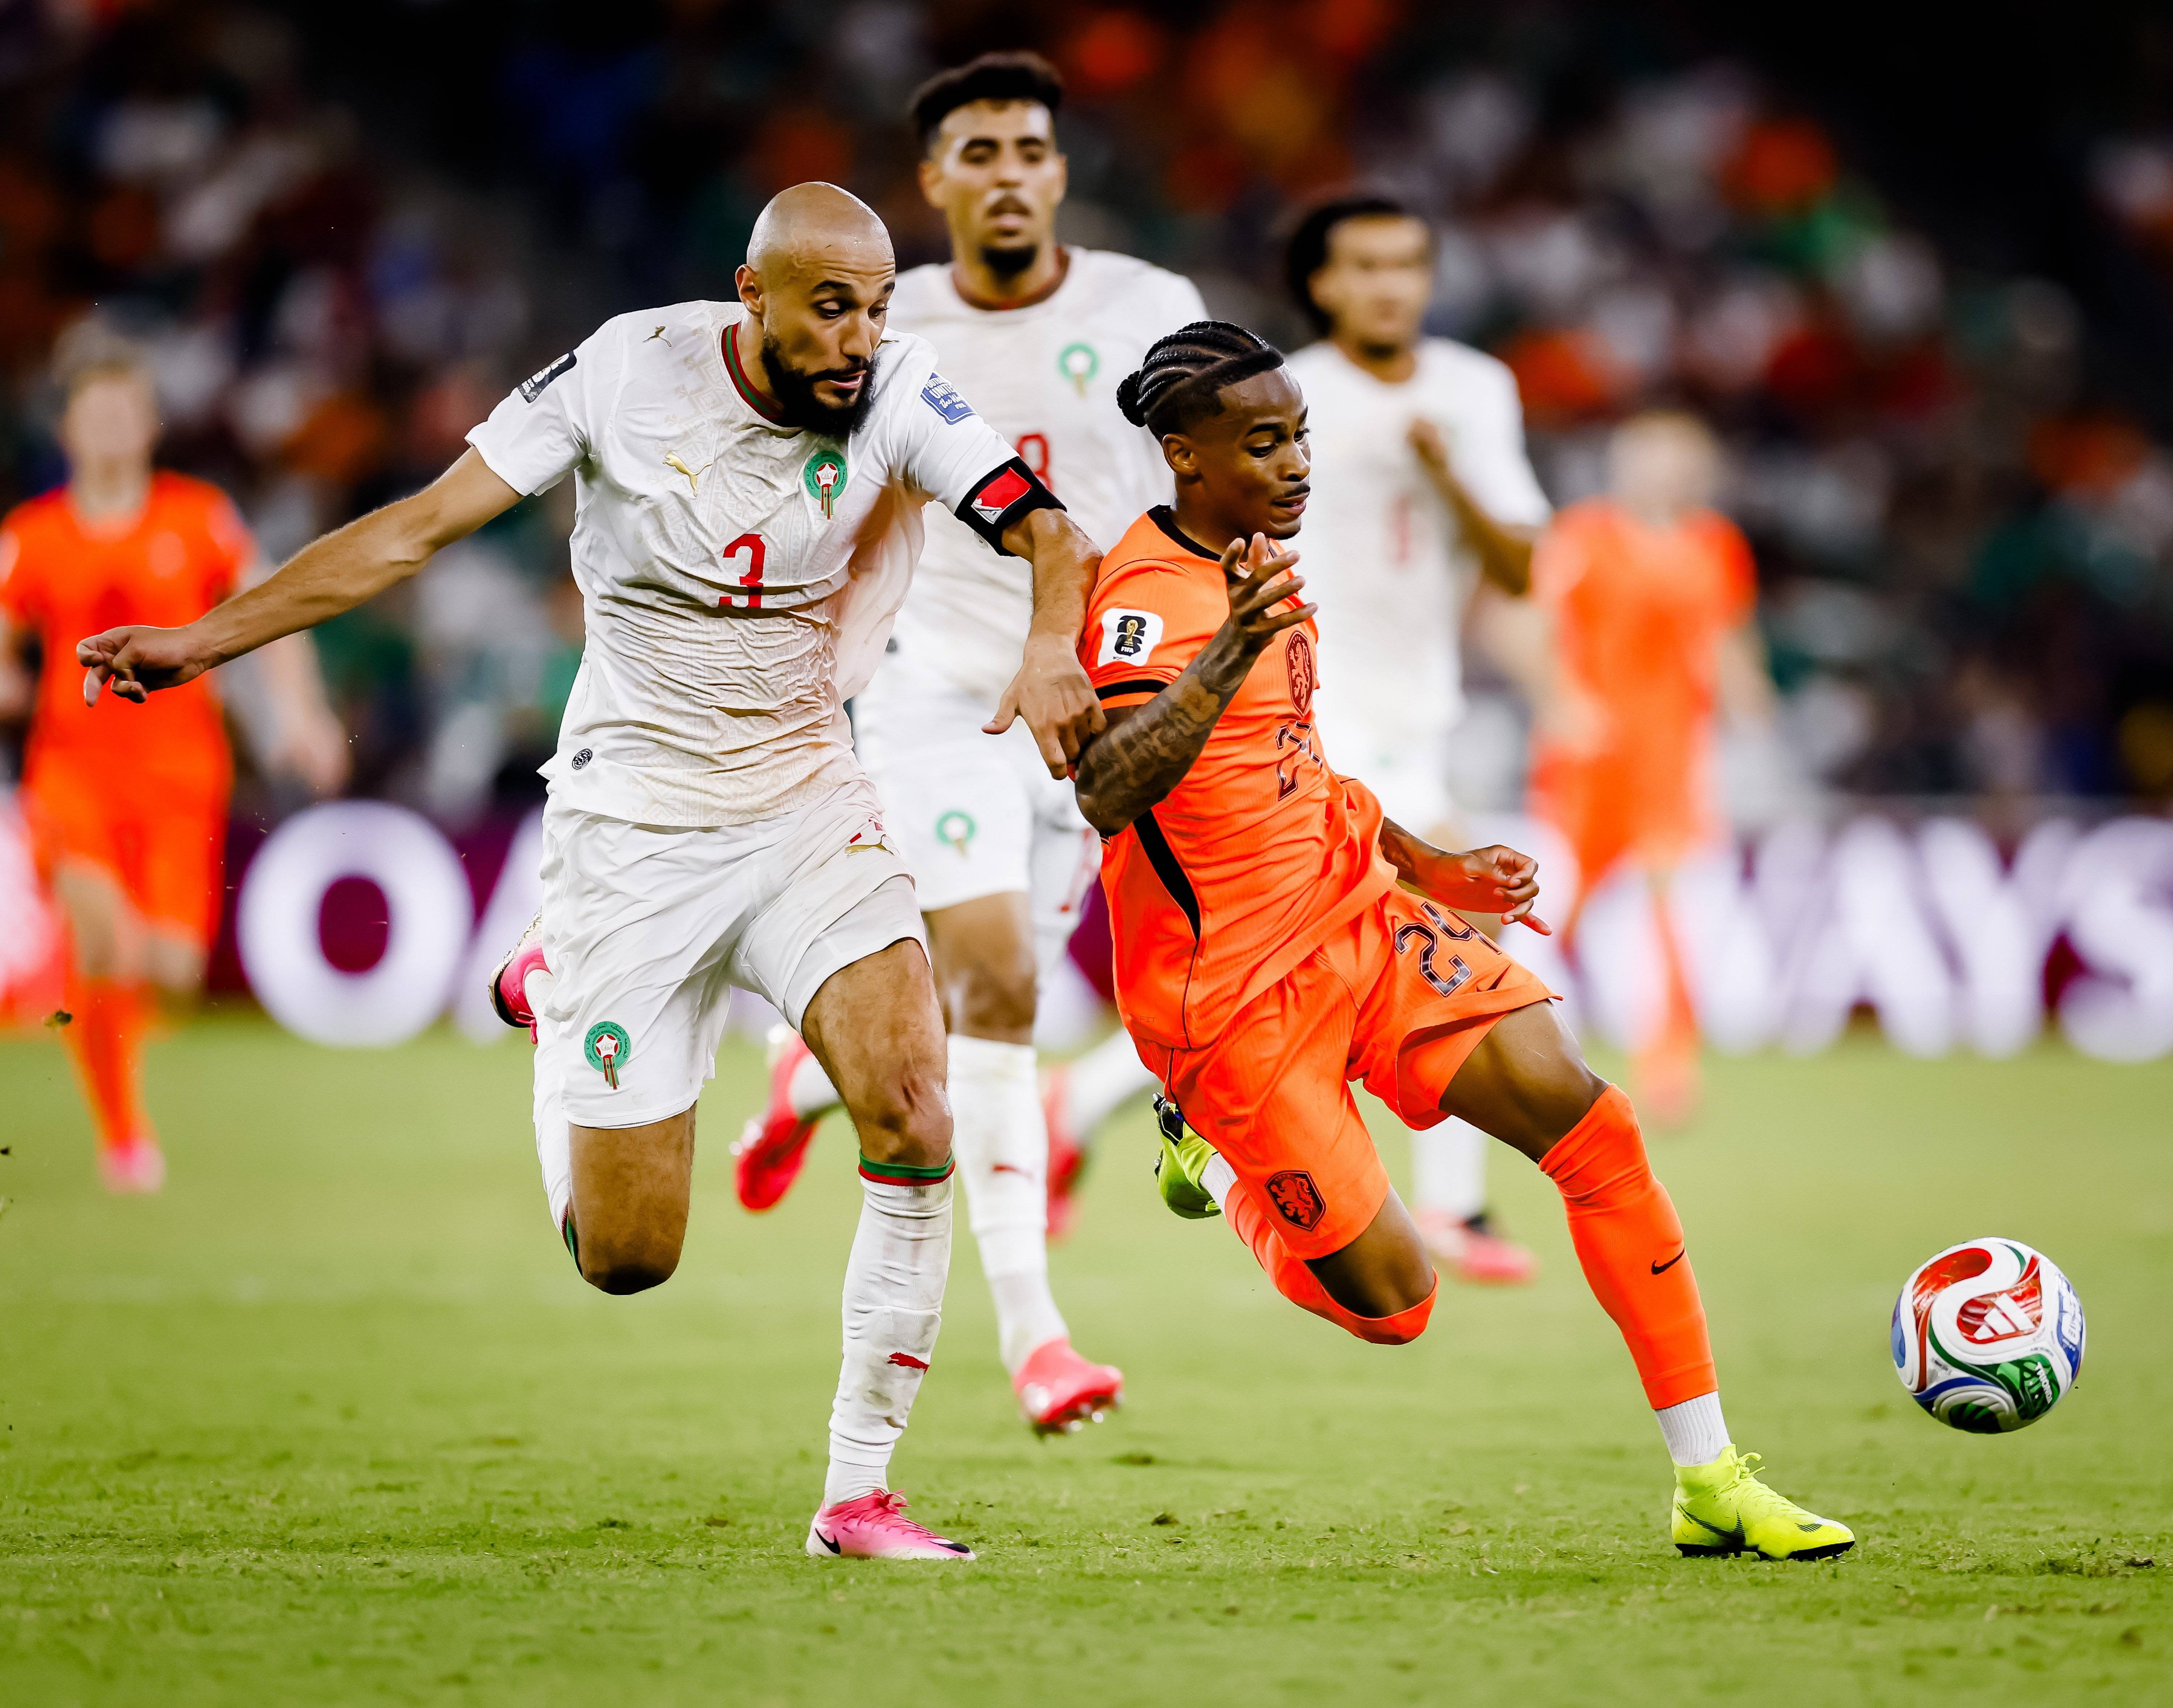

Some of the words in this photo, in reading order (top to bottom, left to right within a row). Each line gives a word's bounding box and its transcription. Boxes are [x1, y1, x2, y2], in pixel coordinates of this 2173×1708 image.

[929, 383, 955, 399] UNITE
[718, 533, 766, 608] 3
[1394, 901, 1502, 998] 24
